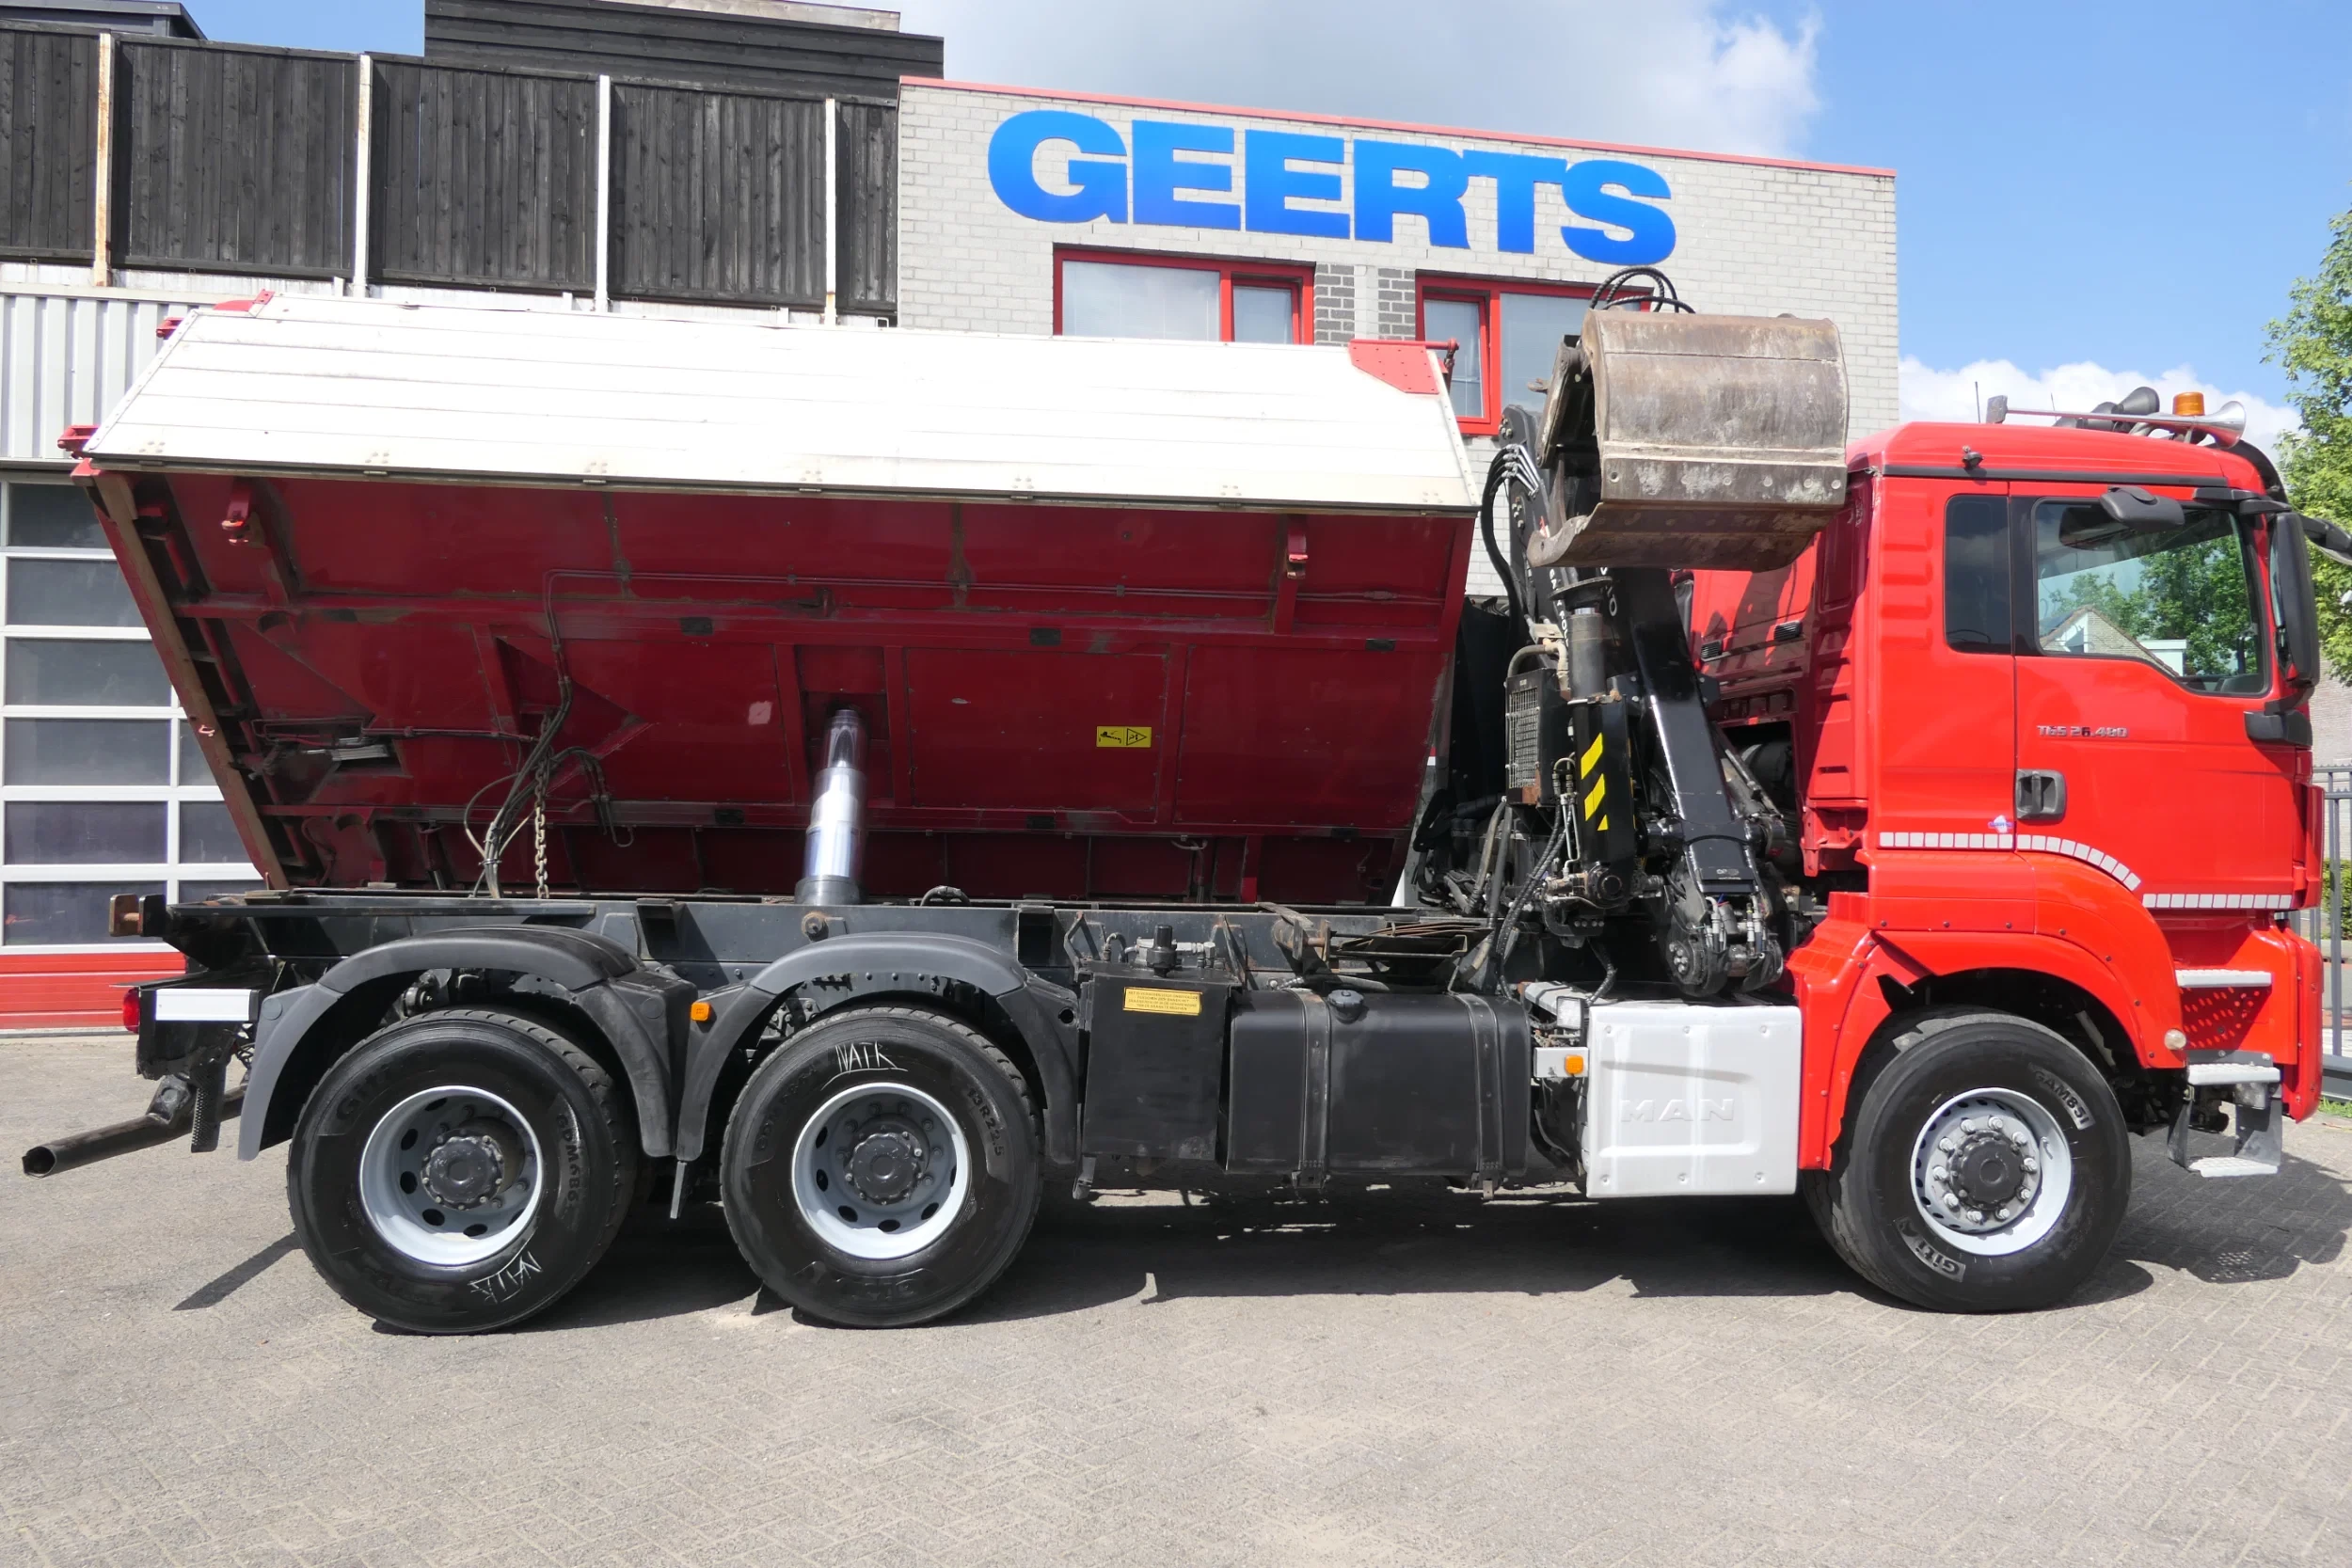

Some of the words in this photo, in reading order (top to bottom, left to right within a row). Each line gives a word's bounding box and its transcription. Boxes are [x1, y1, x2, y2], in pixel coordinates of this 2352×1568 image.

[988, 109, 1677, 266] GEERTS
[2070, 726, 2128, 737] 26.480
[1620, 1099, 1735, 1122] MAN
[2033, 1069, 2090, 1124] GAM851
[1913, 1240, 1961, 1276] Giti
